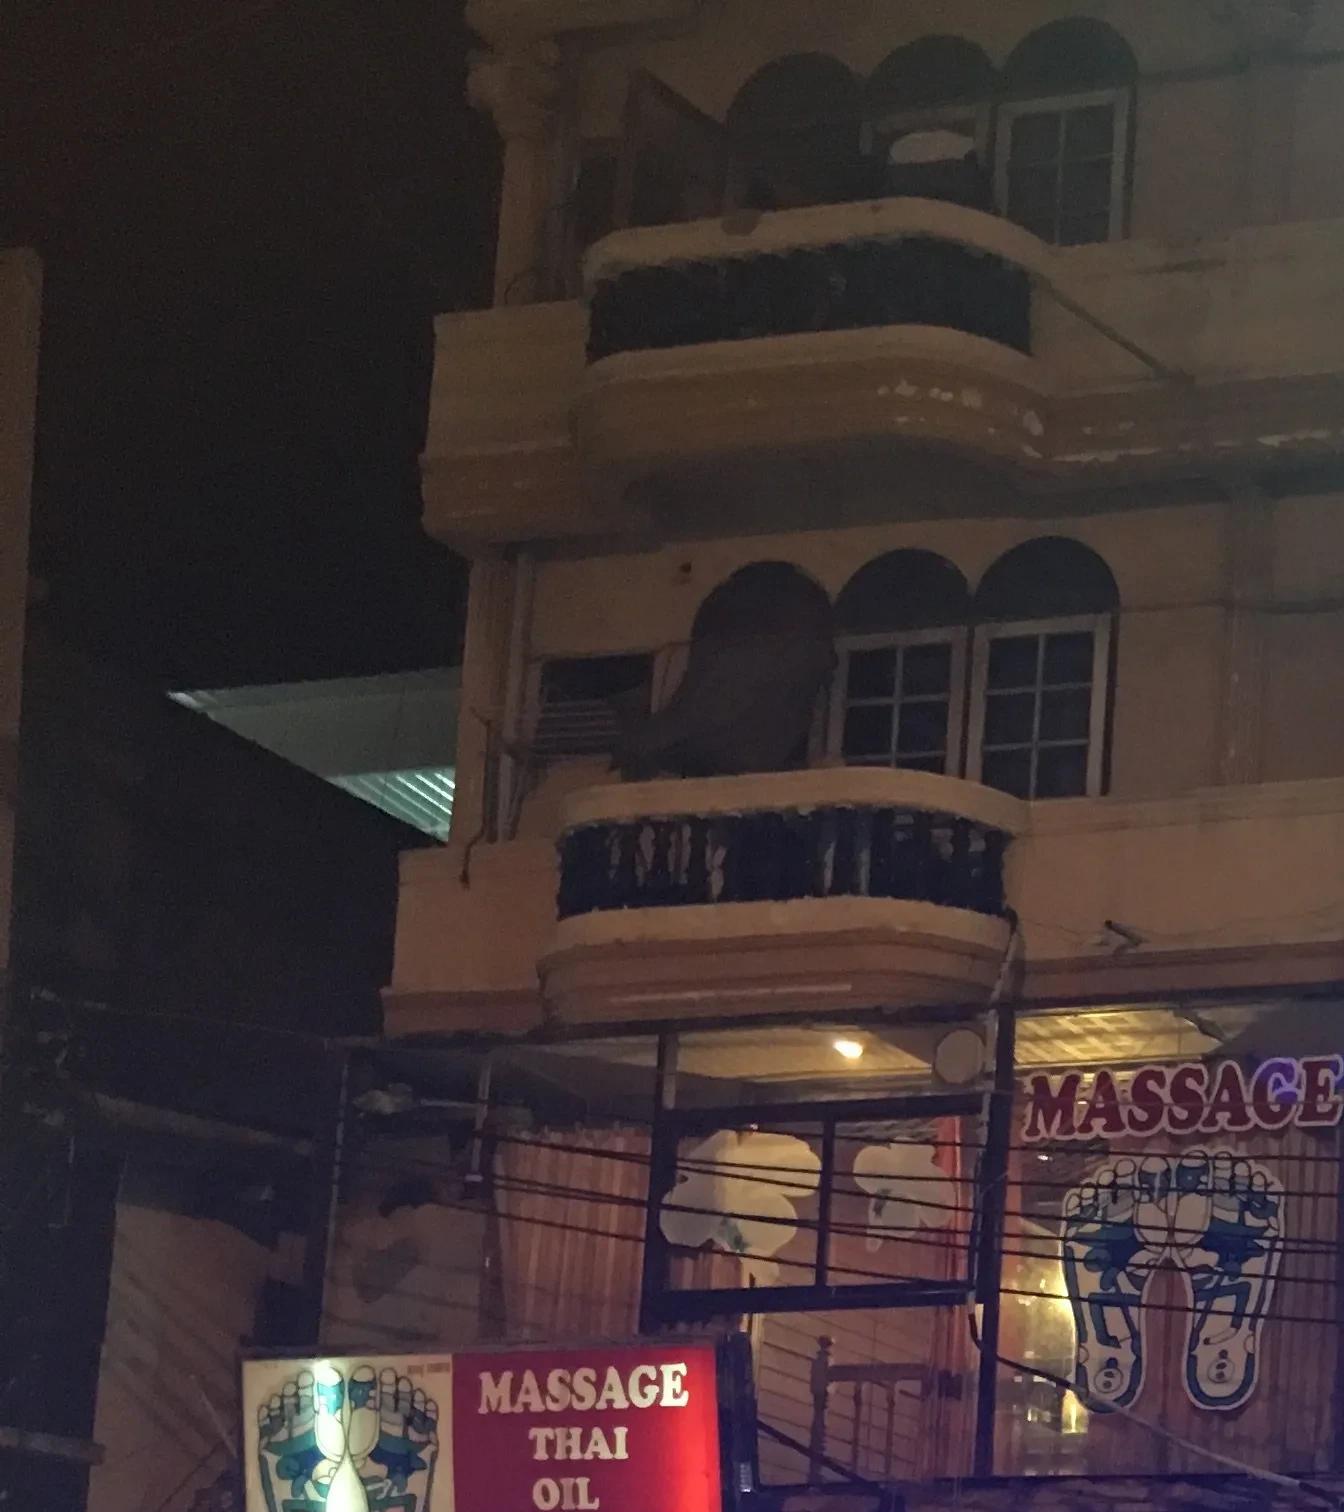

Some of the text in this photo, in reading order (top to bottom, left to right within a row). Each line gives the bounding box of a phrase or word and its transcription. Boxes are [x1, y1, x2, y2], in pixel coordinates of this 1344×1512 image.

[1020, 1054, 1344, 1141] MASSAGE
[478, 1362, 690, 1415] MASSAGE
[528, 1427, 630, 1461] THAI
[533, 1478, 600, 1511] OIL
